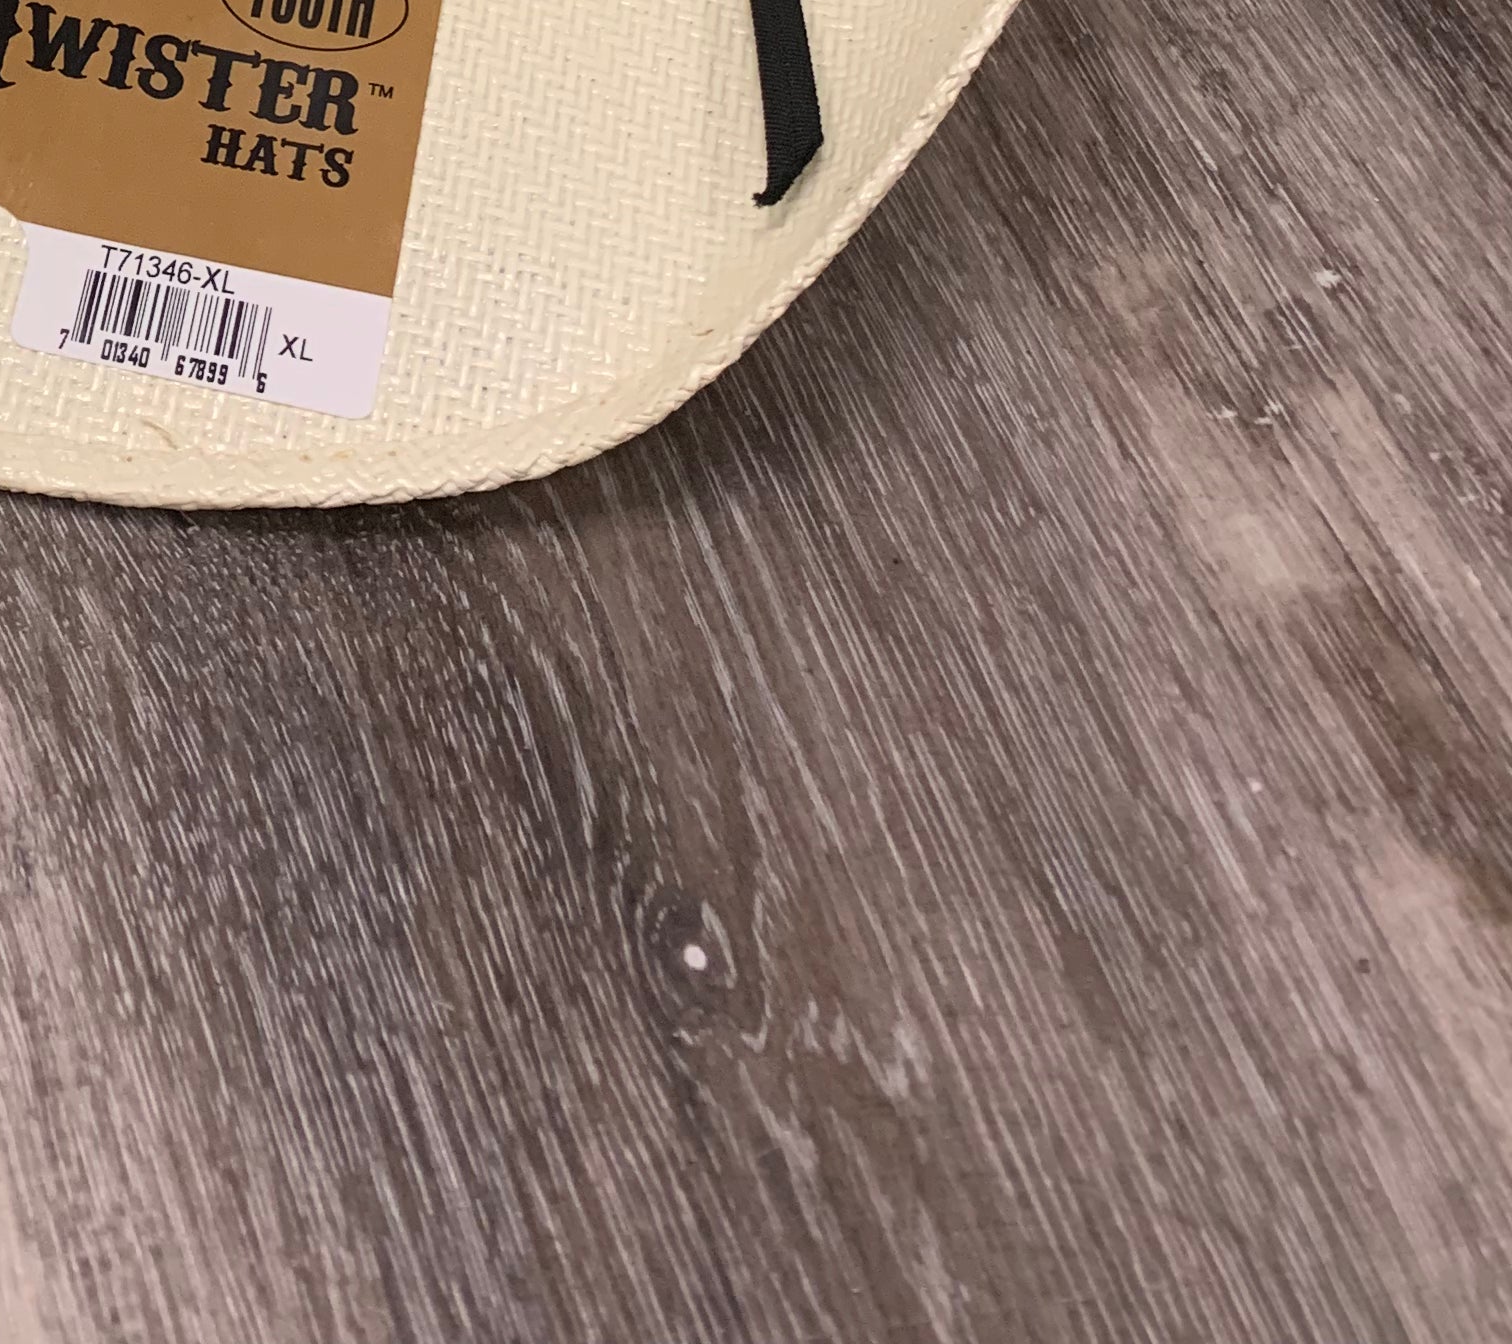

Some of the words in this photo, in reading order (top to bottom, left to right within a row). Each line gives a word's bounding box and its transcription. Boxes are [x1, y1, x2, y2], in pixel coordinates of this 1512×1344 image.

[200, 124, 355, 189] HATS
[101, 244, 235, 295] T71346-XL
[58, 328, 70, 350] 7
[100, 339, 151, 368] 01340
[278, 334, 313, 362] XL
